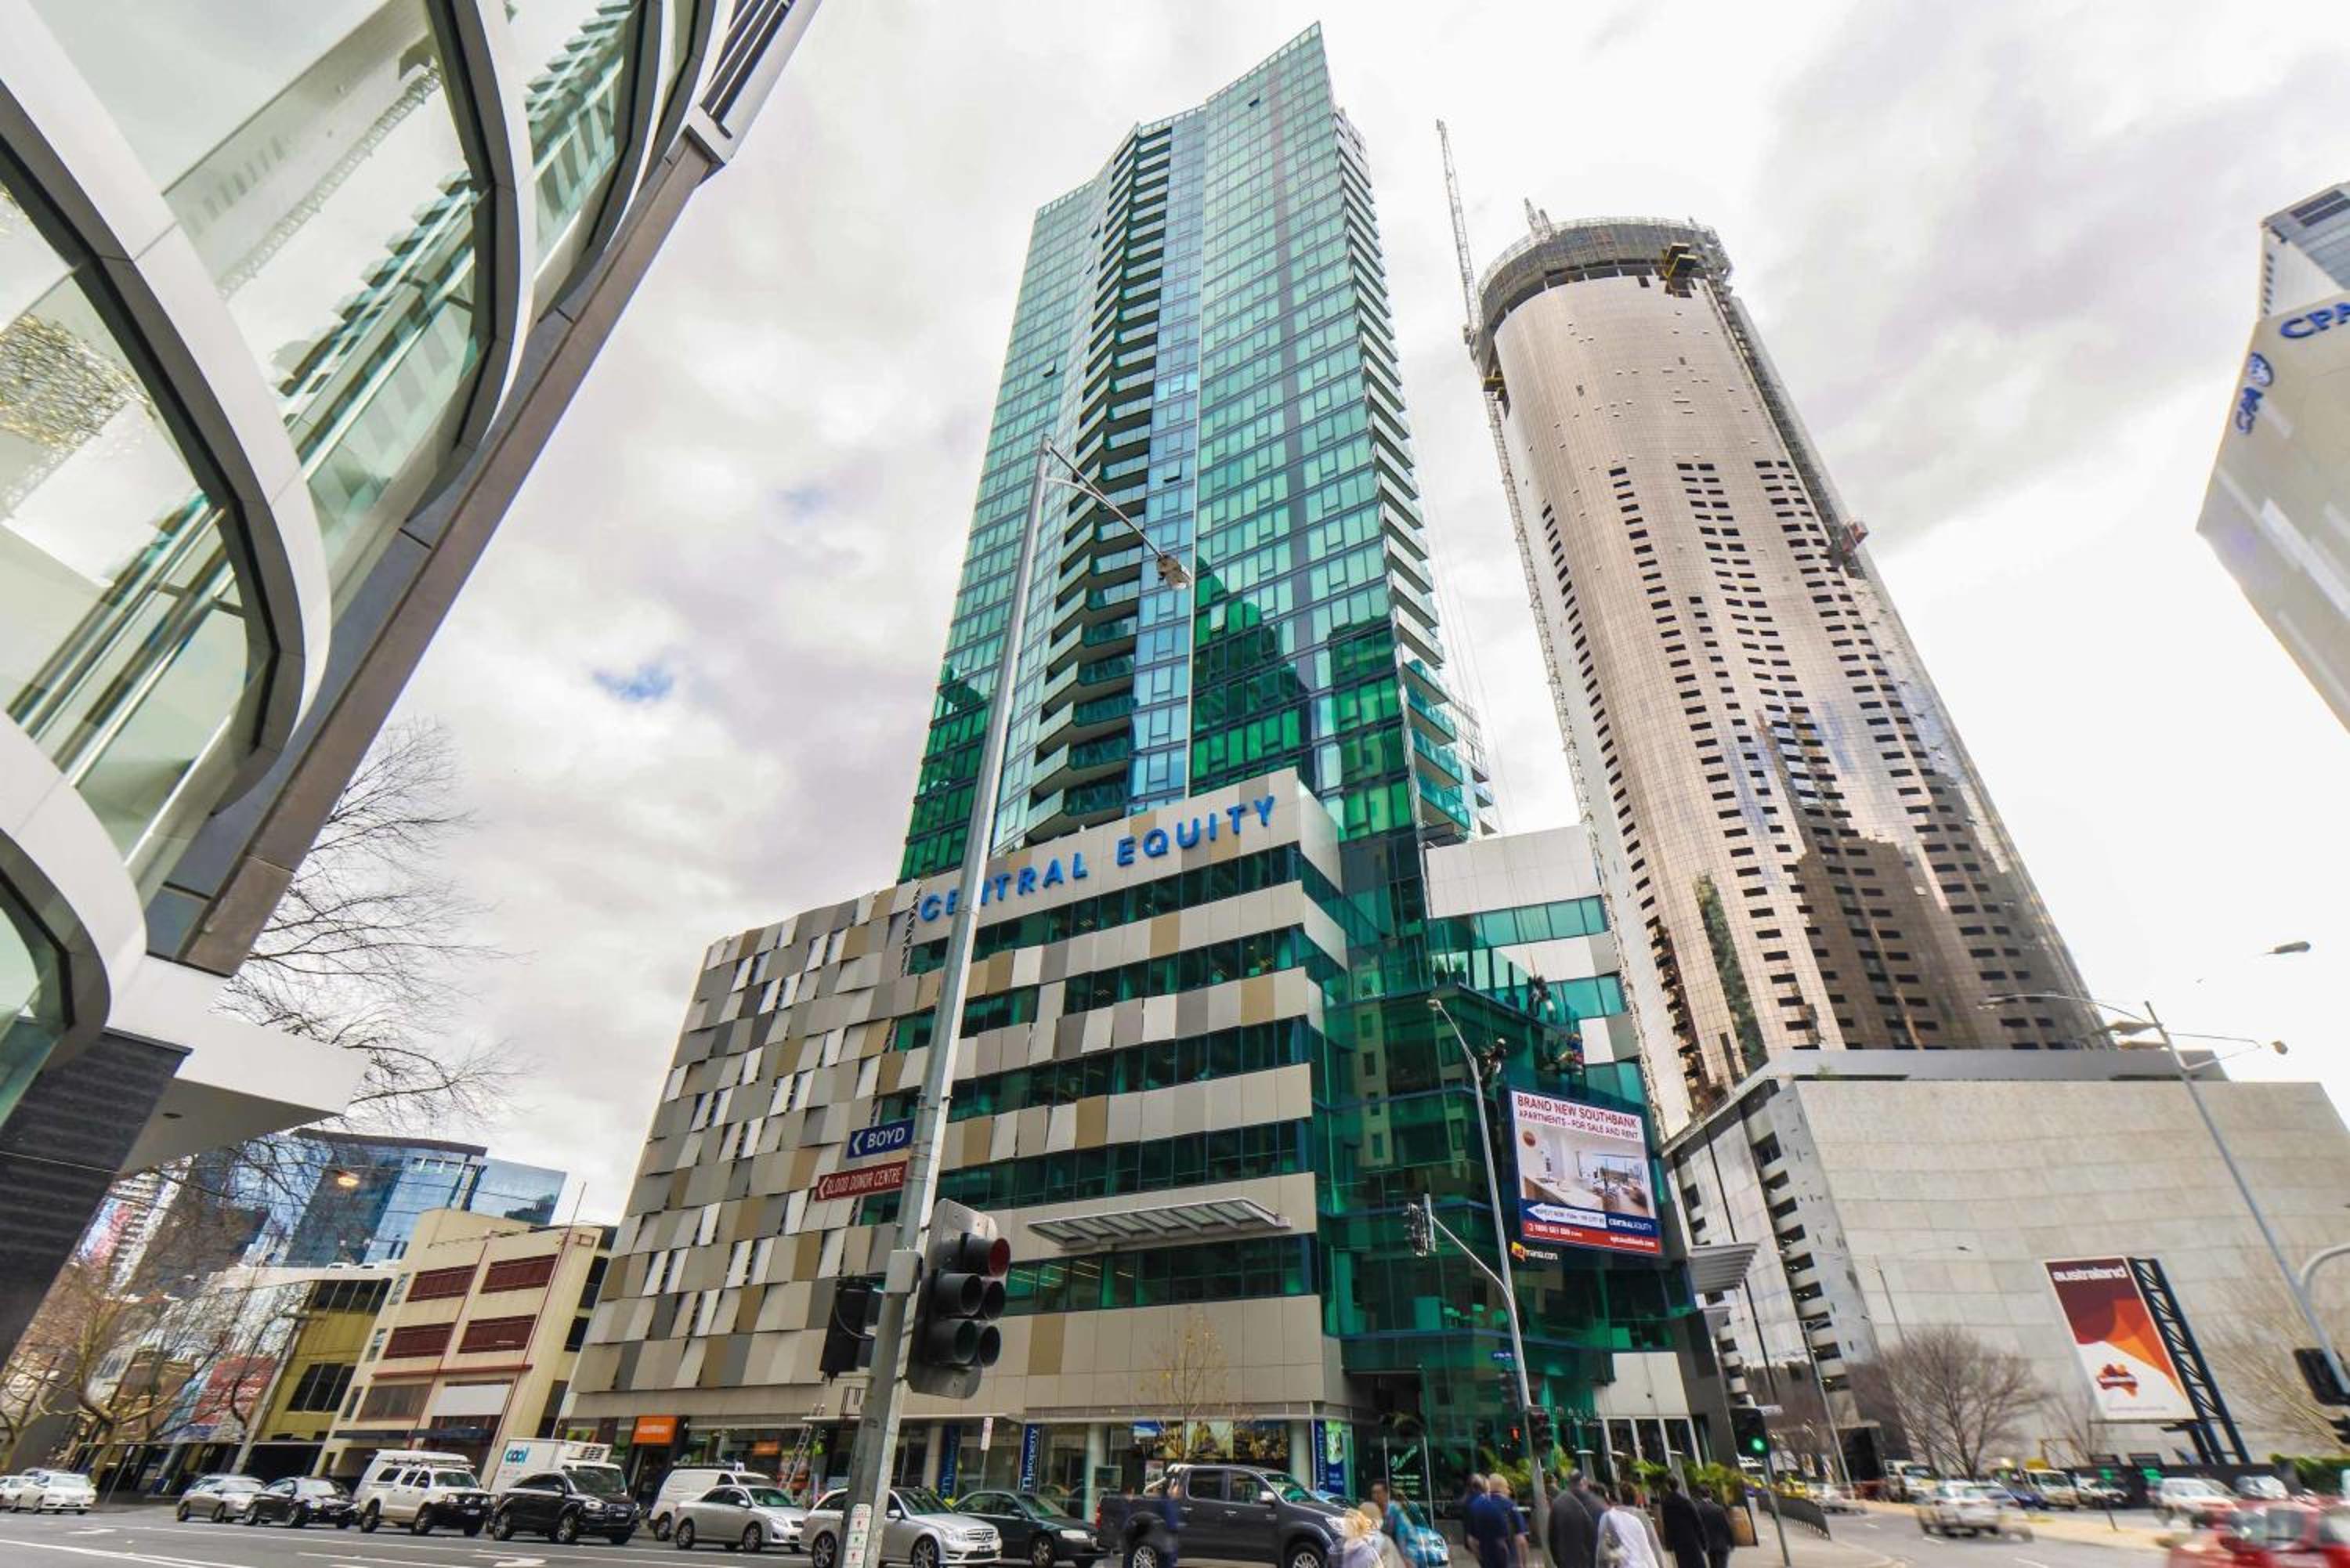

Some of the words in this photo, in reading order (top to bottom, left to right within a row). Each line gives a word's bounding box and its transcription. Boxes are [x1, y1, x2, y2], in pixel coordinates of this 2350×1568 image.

[1117, 795, 1275, 867] EQUITY
[1517, 1095, 1551, 1111] BRAND
[1554, 1104, 1576, 1117] NEW
[1579, 1107, 1636, 1128] SOUTHBANK
[1519, 1110, 1566, 1126] APARTMENTS
[1572, 1120, 1585, 1129] FOR
[1587, 1122, 1603, 1133] SALE
[1606, 1127, 1620, 1136] AND
[1622, 1130, 1638, 1140] RENT
[867, 1127, 905, 1148] BOYD
[873, 1167, 902, 1187] CENTRE
[1027, 1428, 1040, 1476] property
